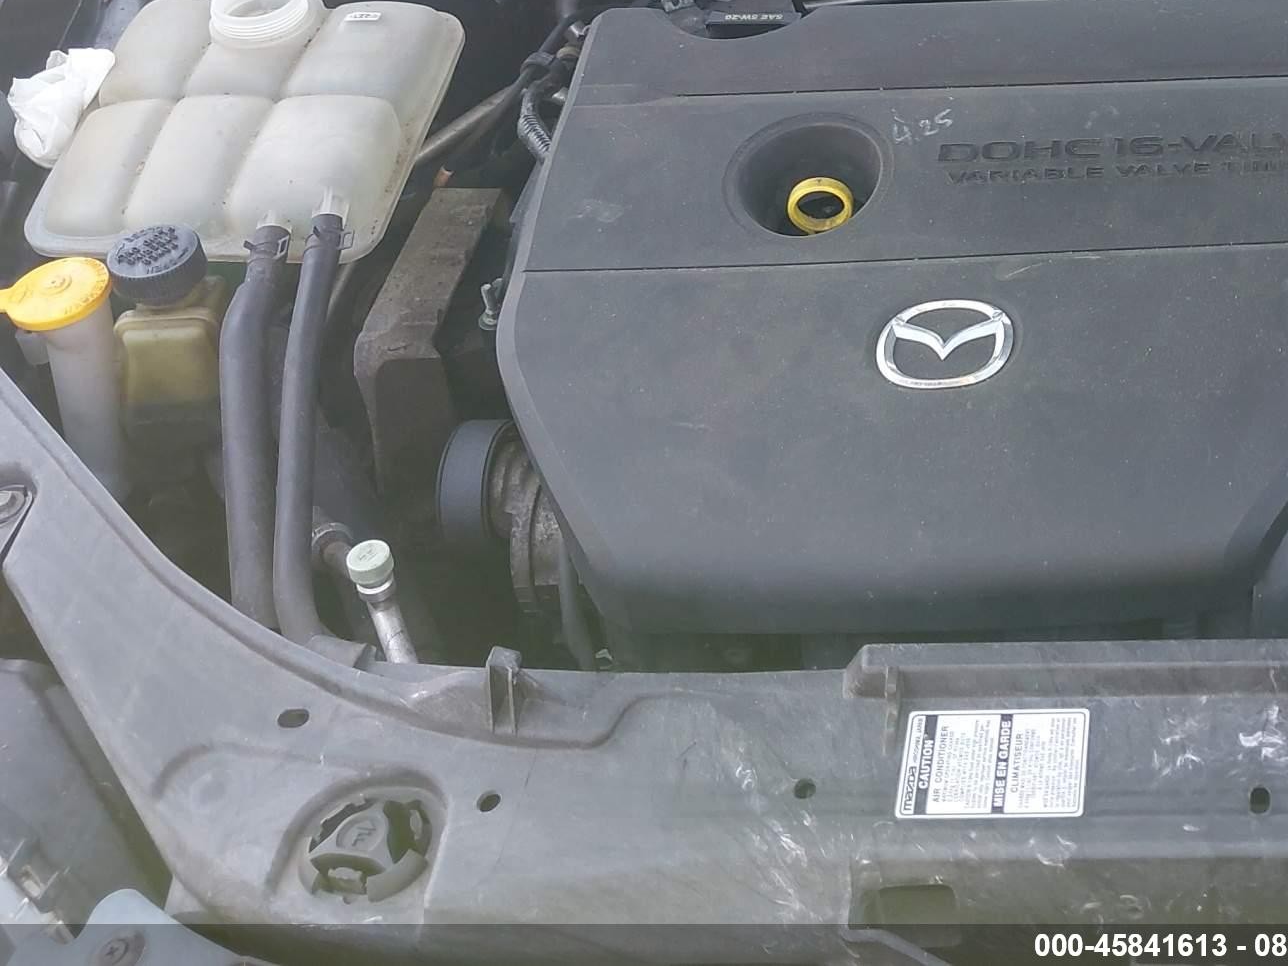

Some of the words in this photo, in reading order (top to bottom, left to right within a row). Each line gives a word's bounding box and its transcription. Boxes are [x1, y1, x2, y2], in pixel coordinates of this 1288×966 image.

[937, 137, 1104, 163] DOHC
[944, 165, 1105, 186] VARIABLE
[1114, 161, 1212, 180] VALVE
[934, 725, 949, 784] CONDITIONER
[998, 720, 1011, 759] GARDE
[918, 739, 934, 789] CAUTION
[996, 761, 1008, 777] EN
[1010, 733, 1024, 793] CLIMATISEUR
[904, 766, 917, 811] mazda
[932, 788, 941, 803] AIR
[993, 779, 1005, 807] MISE
